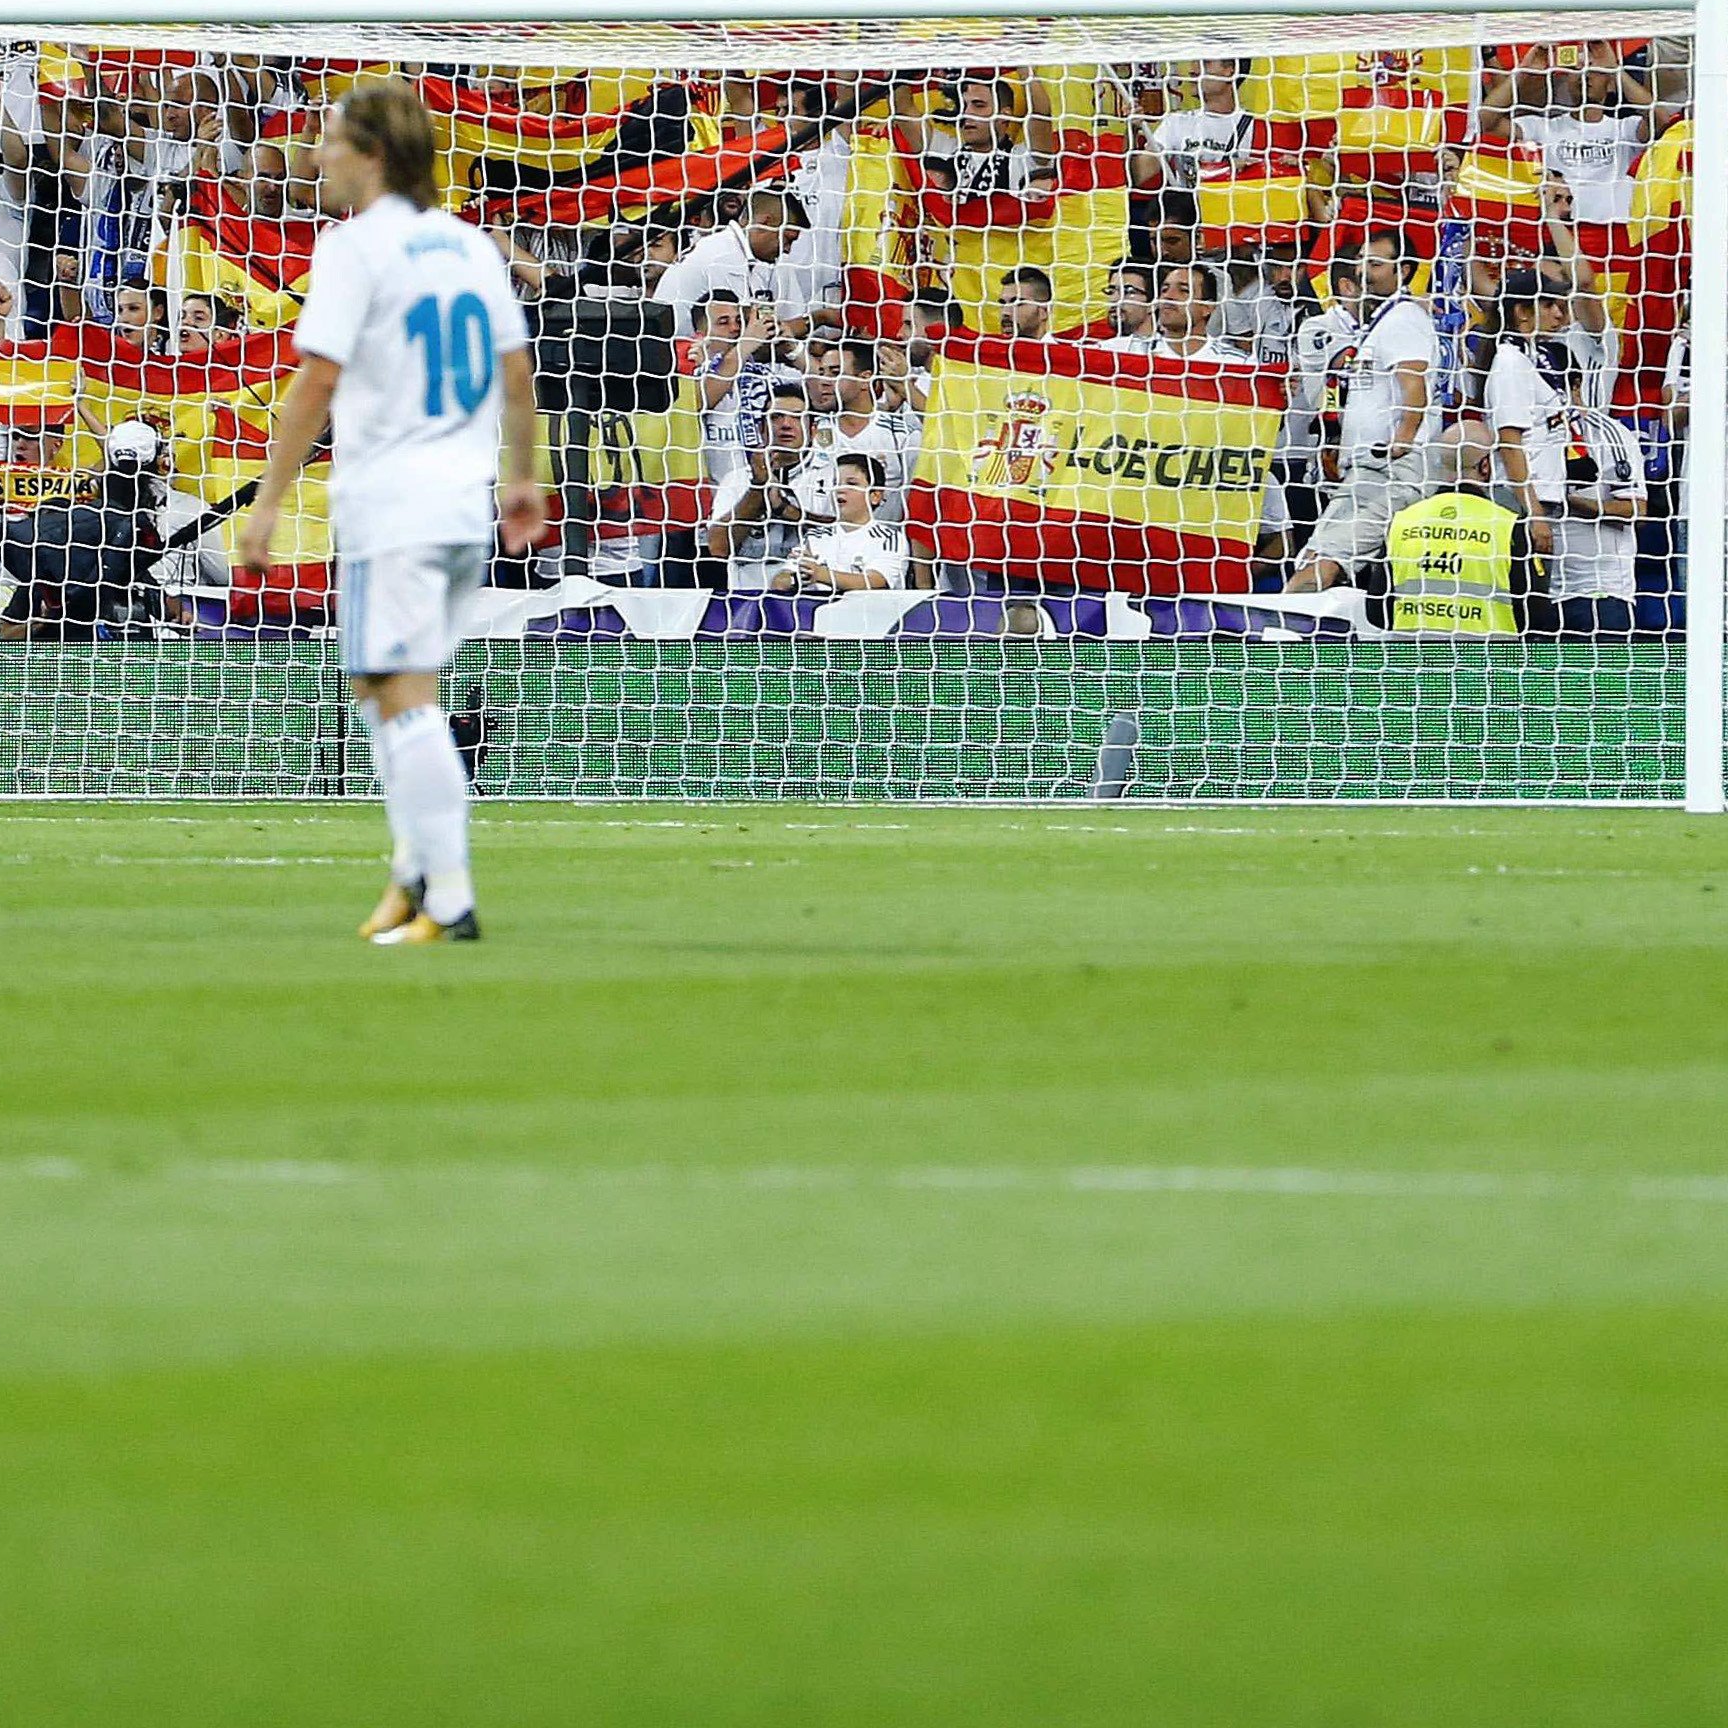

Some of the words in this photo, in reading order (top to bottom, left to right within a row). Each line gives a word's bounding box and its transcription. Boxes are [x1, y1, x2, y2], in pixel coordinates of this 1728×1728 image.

[403, 289, 495, 419] 10
[1065, 426, 1266, 492] LOECHES
[1401, 524, 1492, 545] SEGURIDAD
[1418, 551, 1463, 575] 440
[1397, 601, 1483, 621] PROSEGUR
